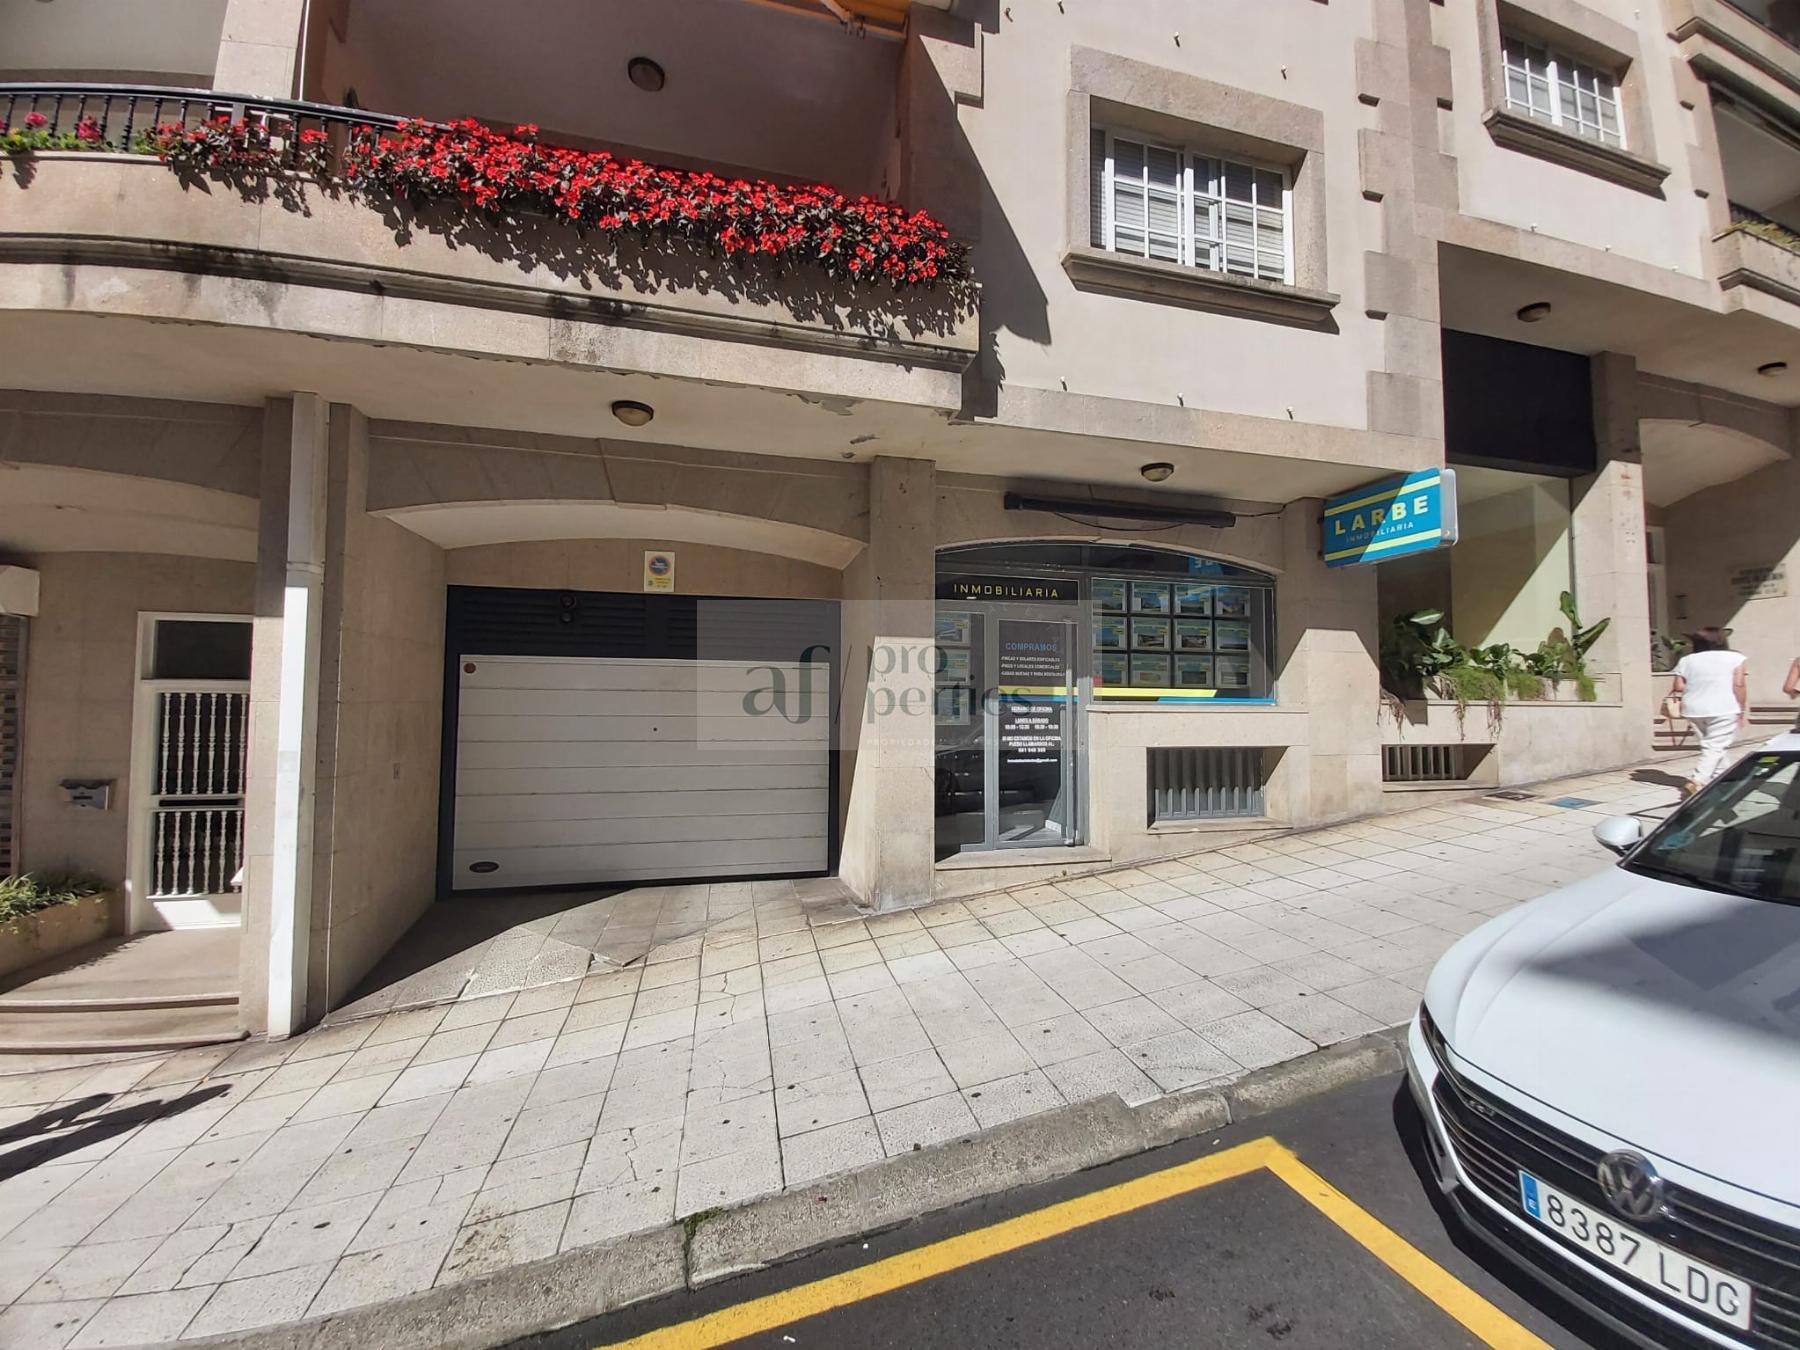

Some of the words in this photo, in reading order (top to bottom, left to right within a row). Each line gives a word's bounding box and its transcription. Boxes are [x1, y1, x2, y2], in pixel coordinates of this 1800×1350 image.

[1334, 494, 1429, 536] LARBE
[1346, 521, 1414, 543] INMOBILIARIA
[953, 583, 1059, 598] INMOBILIARIA
[1005, 642, 1057, 652] COMPRAMOS
[1546, 1193, 1641, 1266] 8387
[1659, 1251, 1739, 1317] LDG
